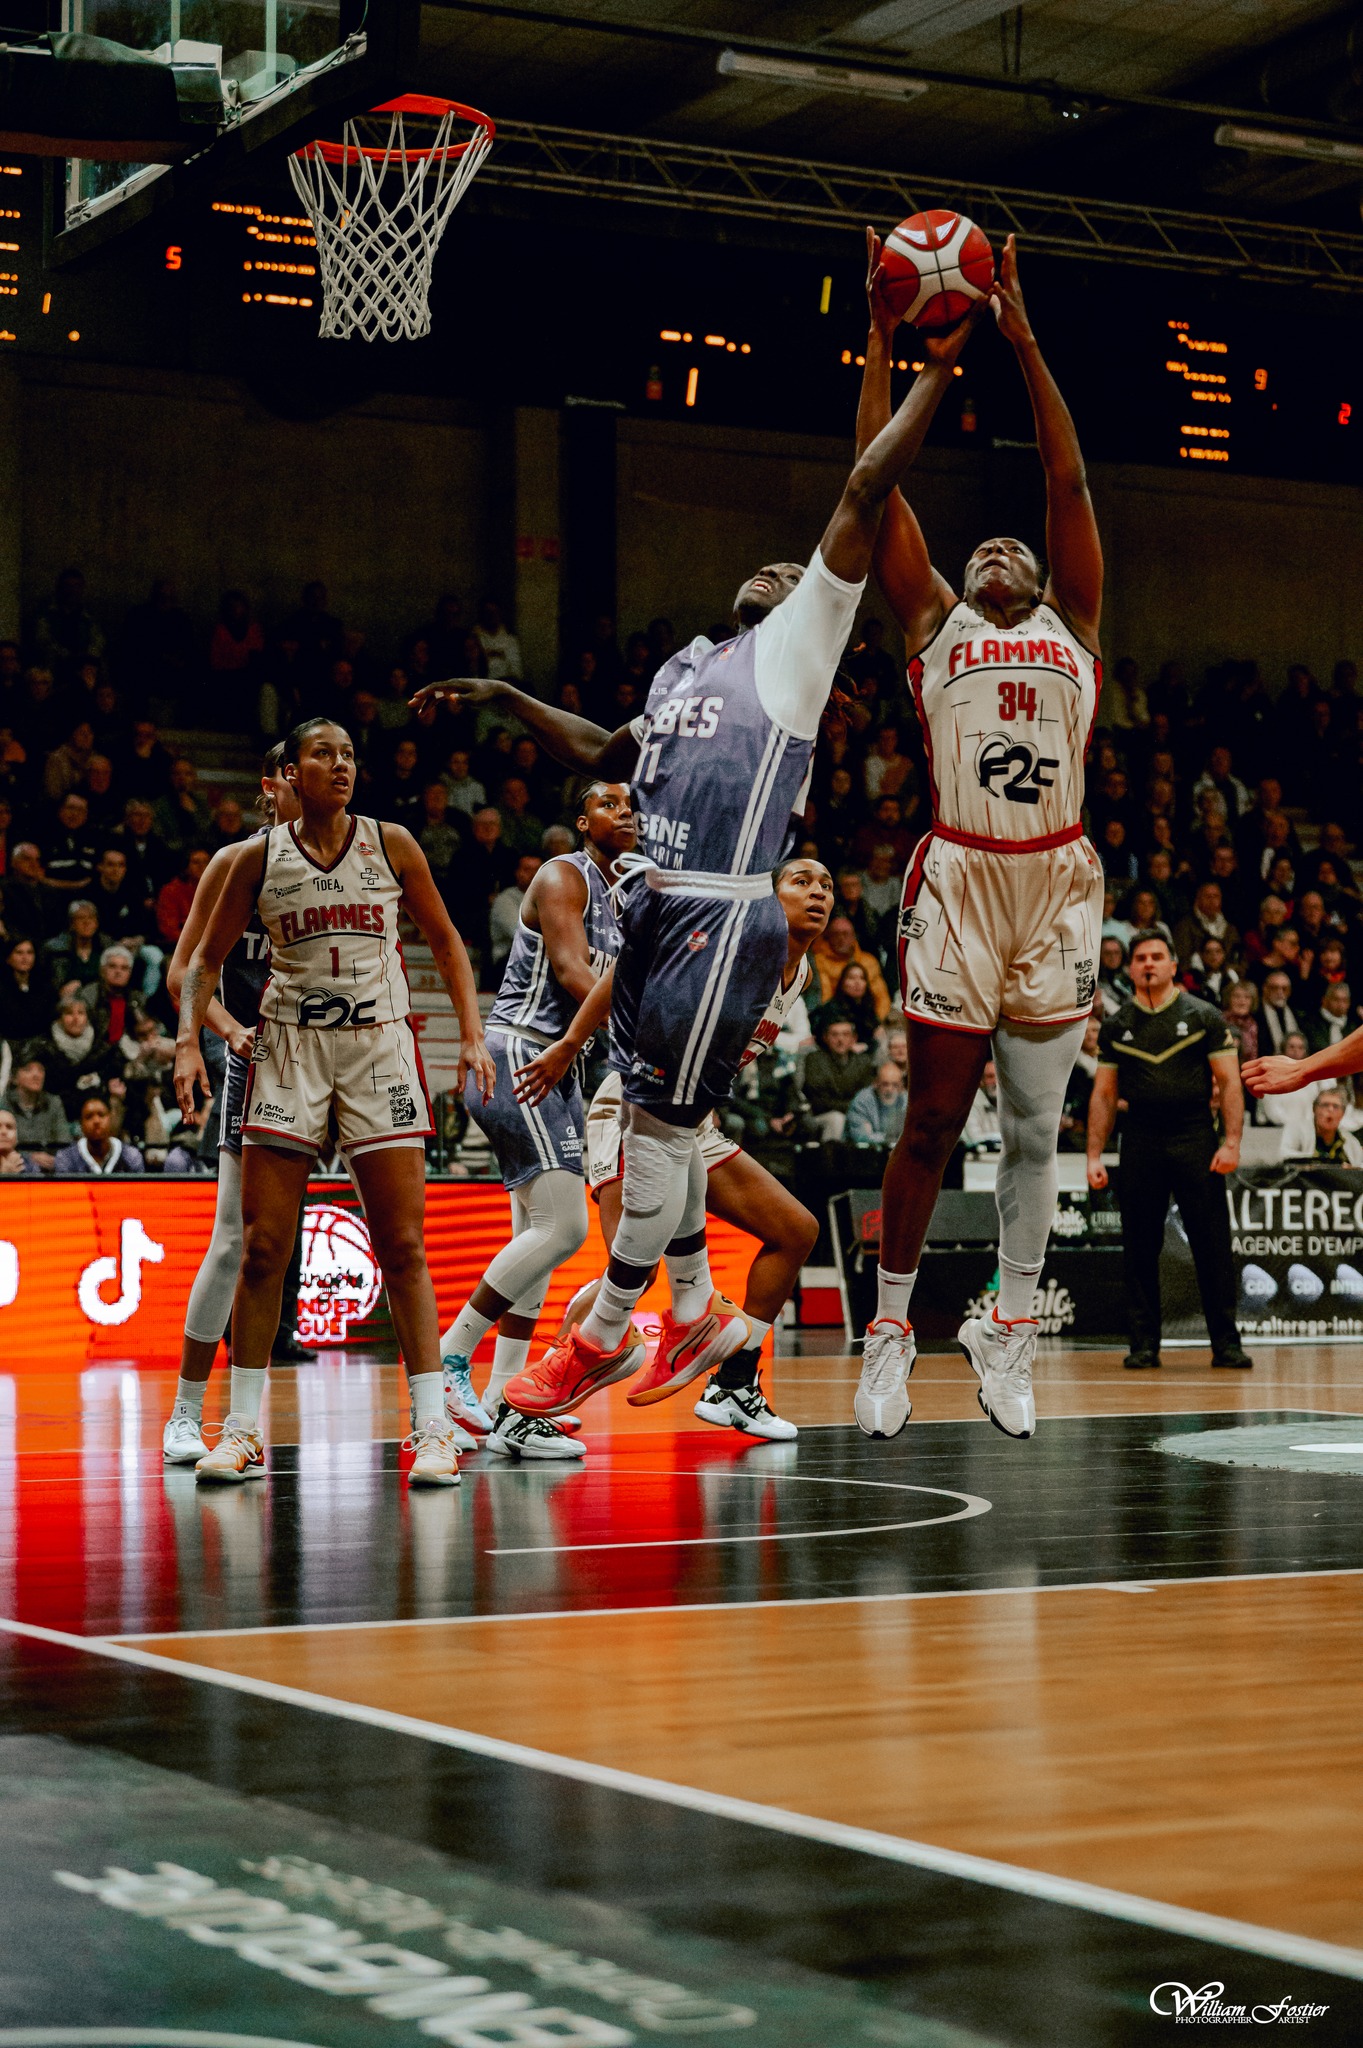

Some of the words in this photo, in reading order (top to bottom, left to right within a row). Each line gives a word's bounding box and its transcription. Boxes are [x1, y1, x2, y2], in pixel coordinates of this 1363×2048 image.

[1254, 368, 1268, 390] 9
[948, 639, 1080, 679] FLAMMES
[998, 681, 1037, 722] 34
[315, 878, 341, 892] IDEA
[279, 904, 385, 943] FLAMMES
[329, 946, 340, 978] 1
[924, 991, 947, 1003] auto
[388, 1084, 410, 1094] MURS
[264, 1103, 285, 1114] auto
[1232, 1236, 1303, 1256] AGENCE
